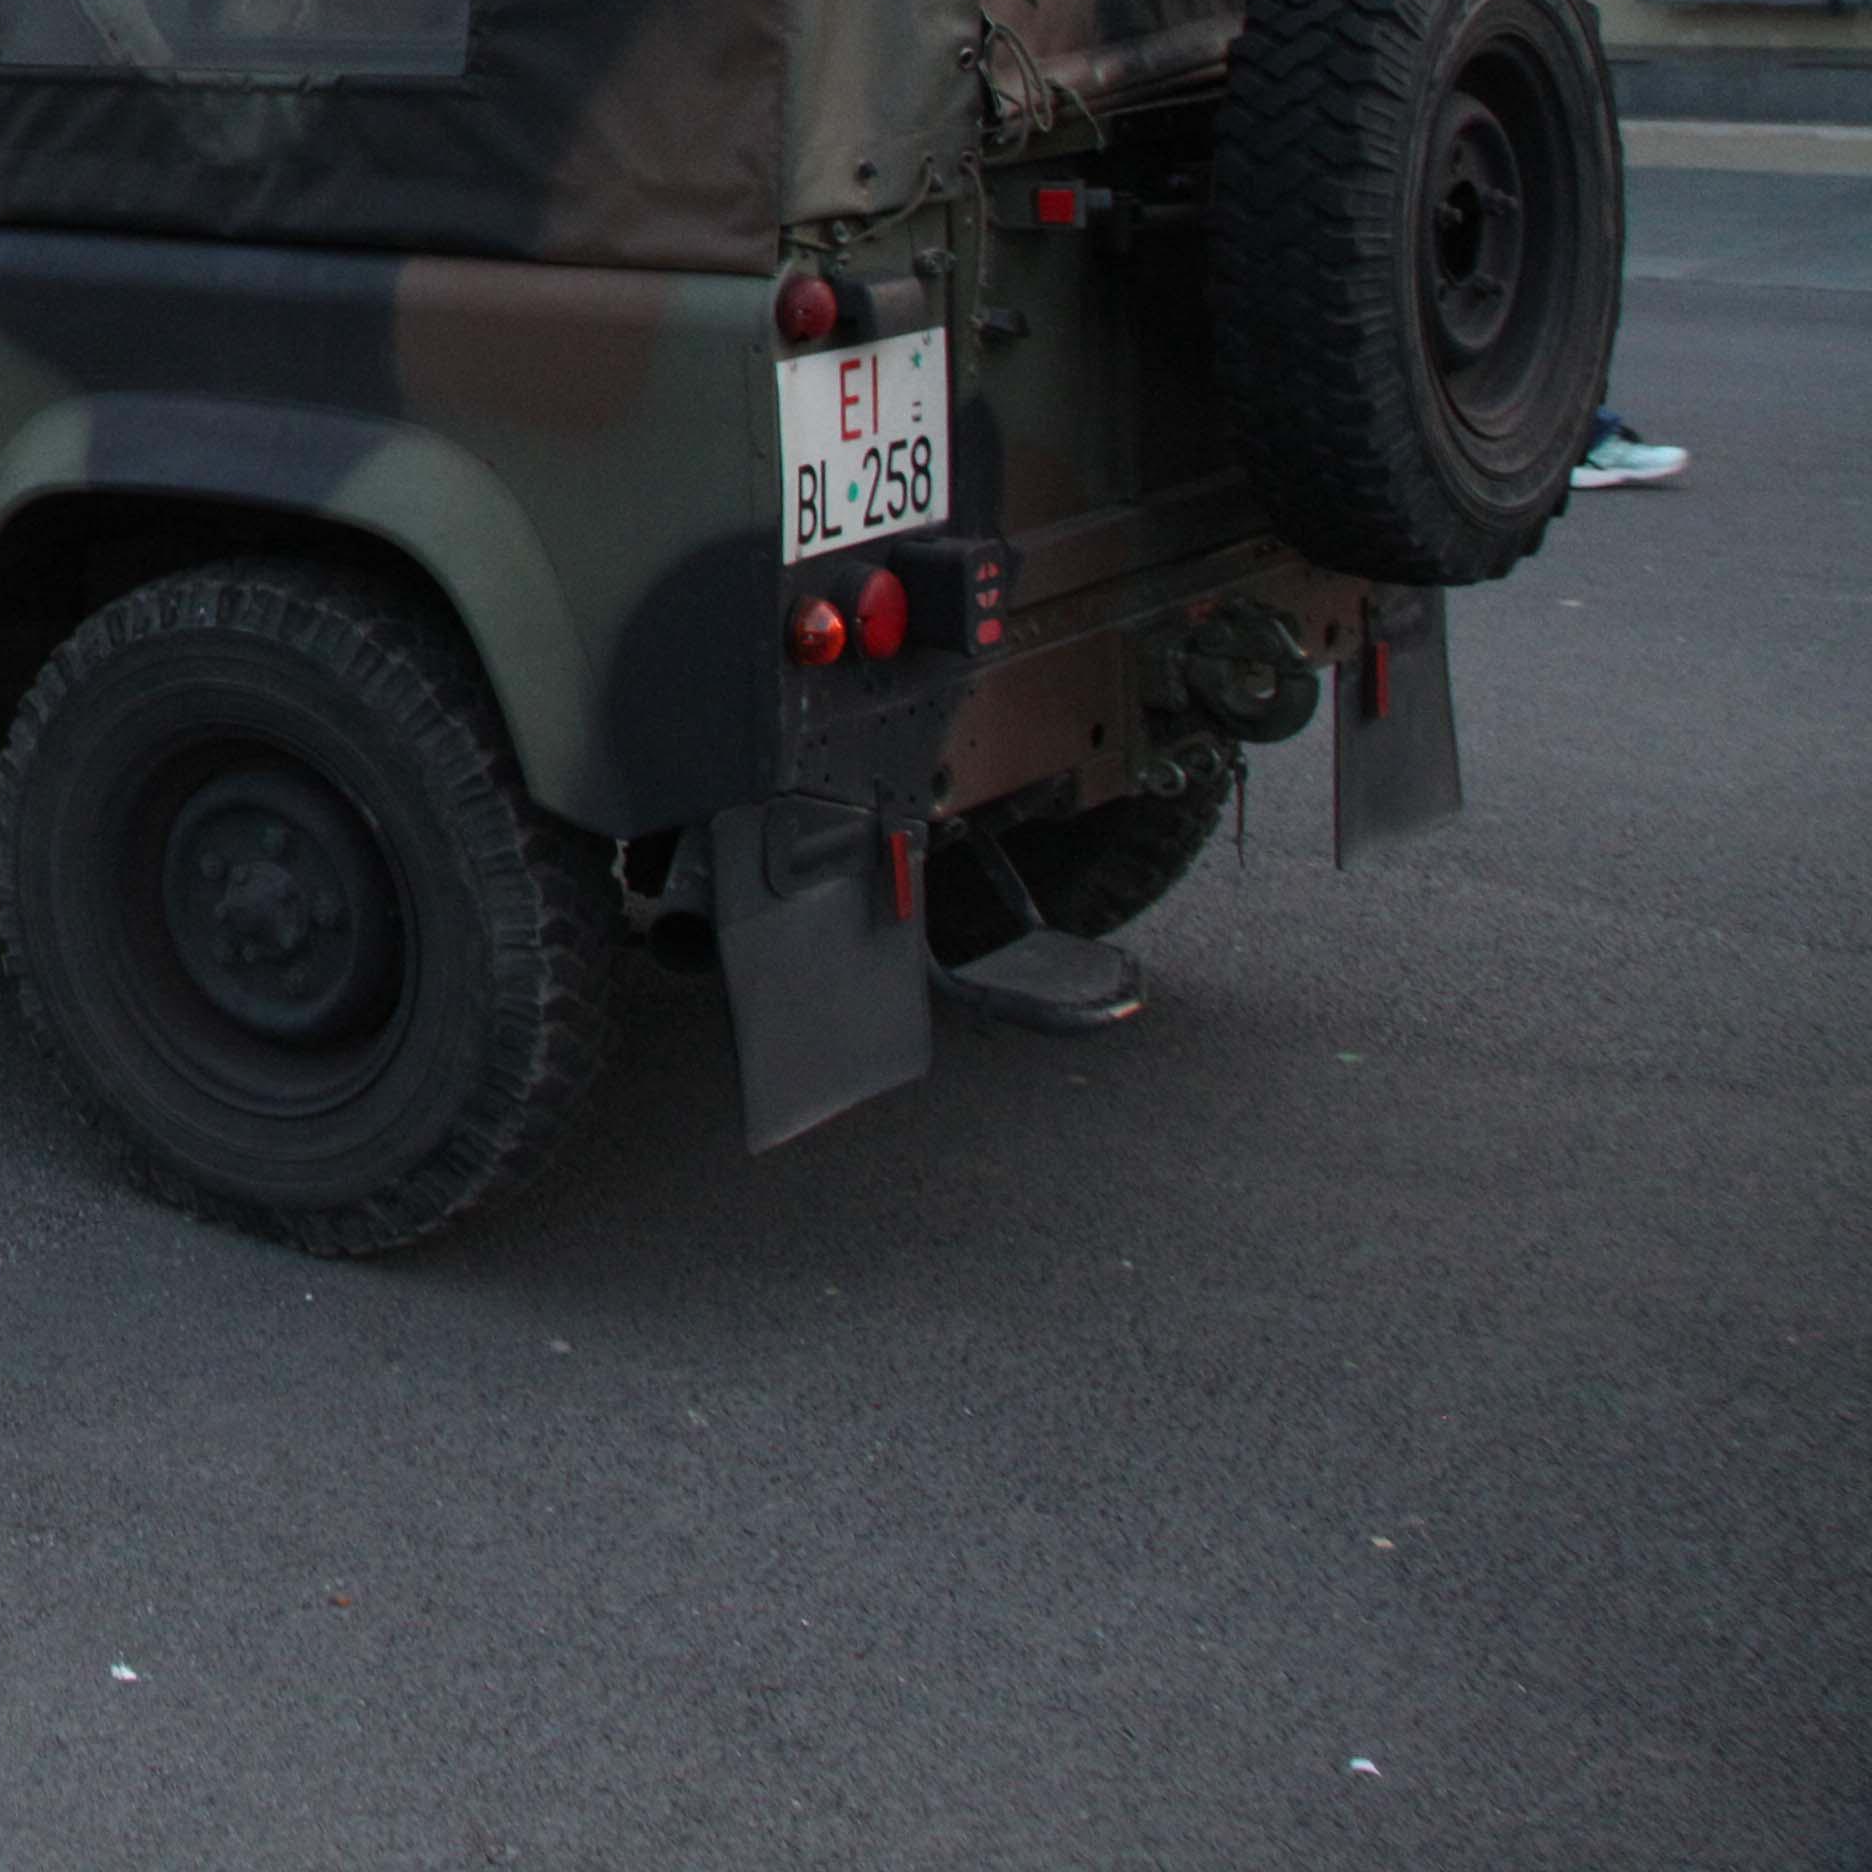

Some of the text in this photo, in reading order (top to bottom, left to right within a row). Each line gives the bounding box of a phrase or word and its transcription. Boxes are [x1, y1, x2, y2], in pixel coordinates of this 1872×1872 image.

[839, 354, 878, 442] EI
[797, 434, 932, 545] BL 258
